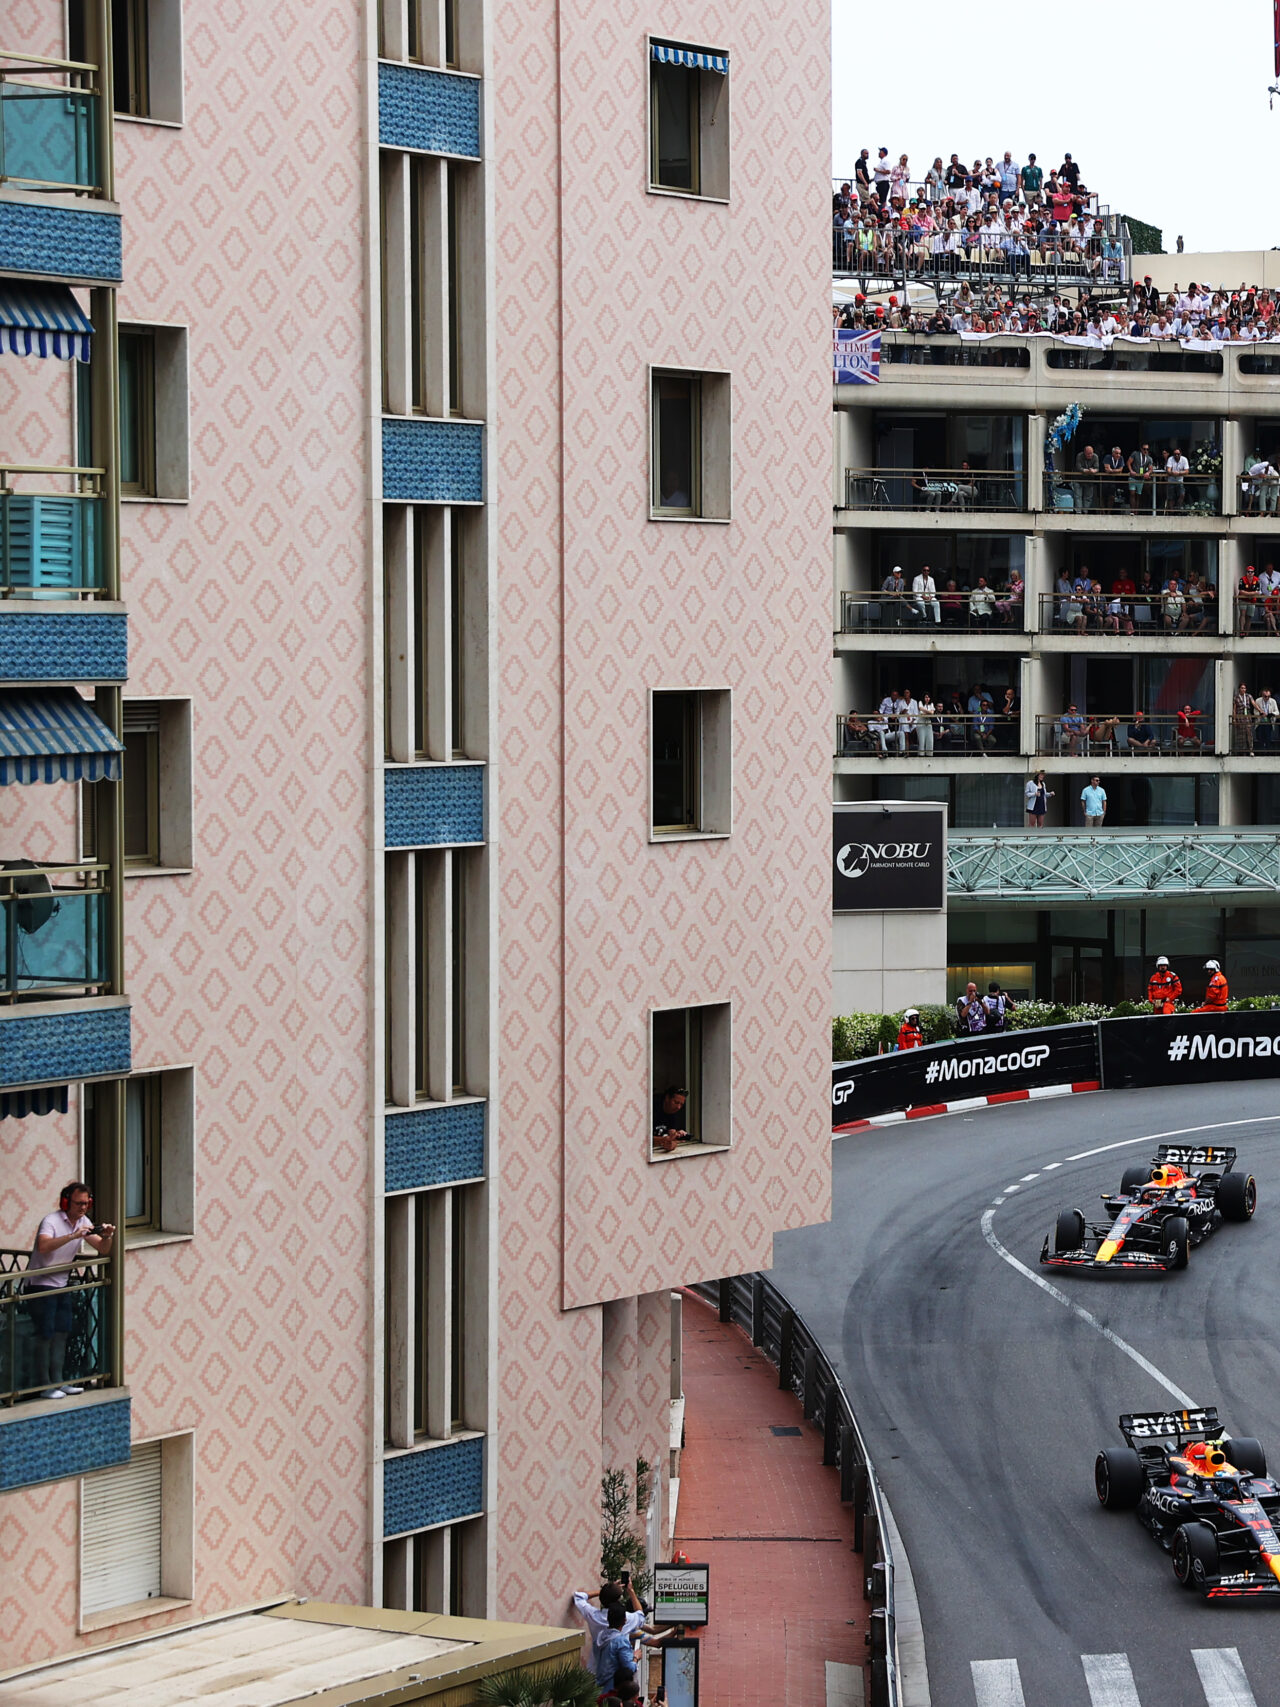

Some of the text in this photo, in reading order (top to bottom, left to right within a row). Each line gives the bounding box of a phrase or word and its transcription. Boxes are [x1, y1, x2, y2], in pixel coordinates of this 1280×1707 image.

[842, 342, 870, 352] TIME
[860, 843, 932, 859] NOBU
[658, 1583, 705, 1591] SPELUGUES
